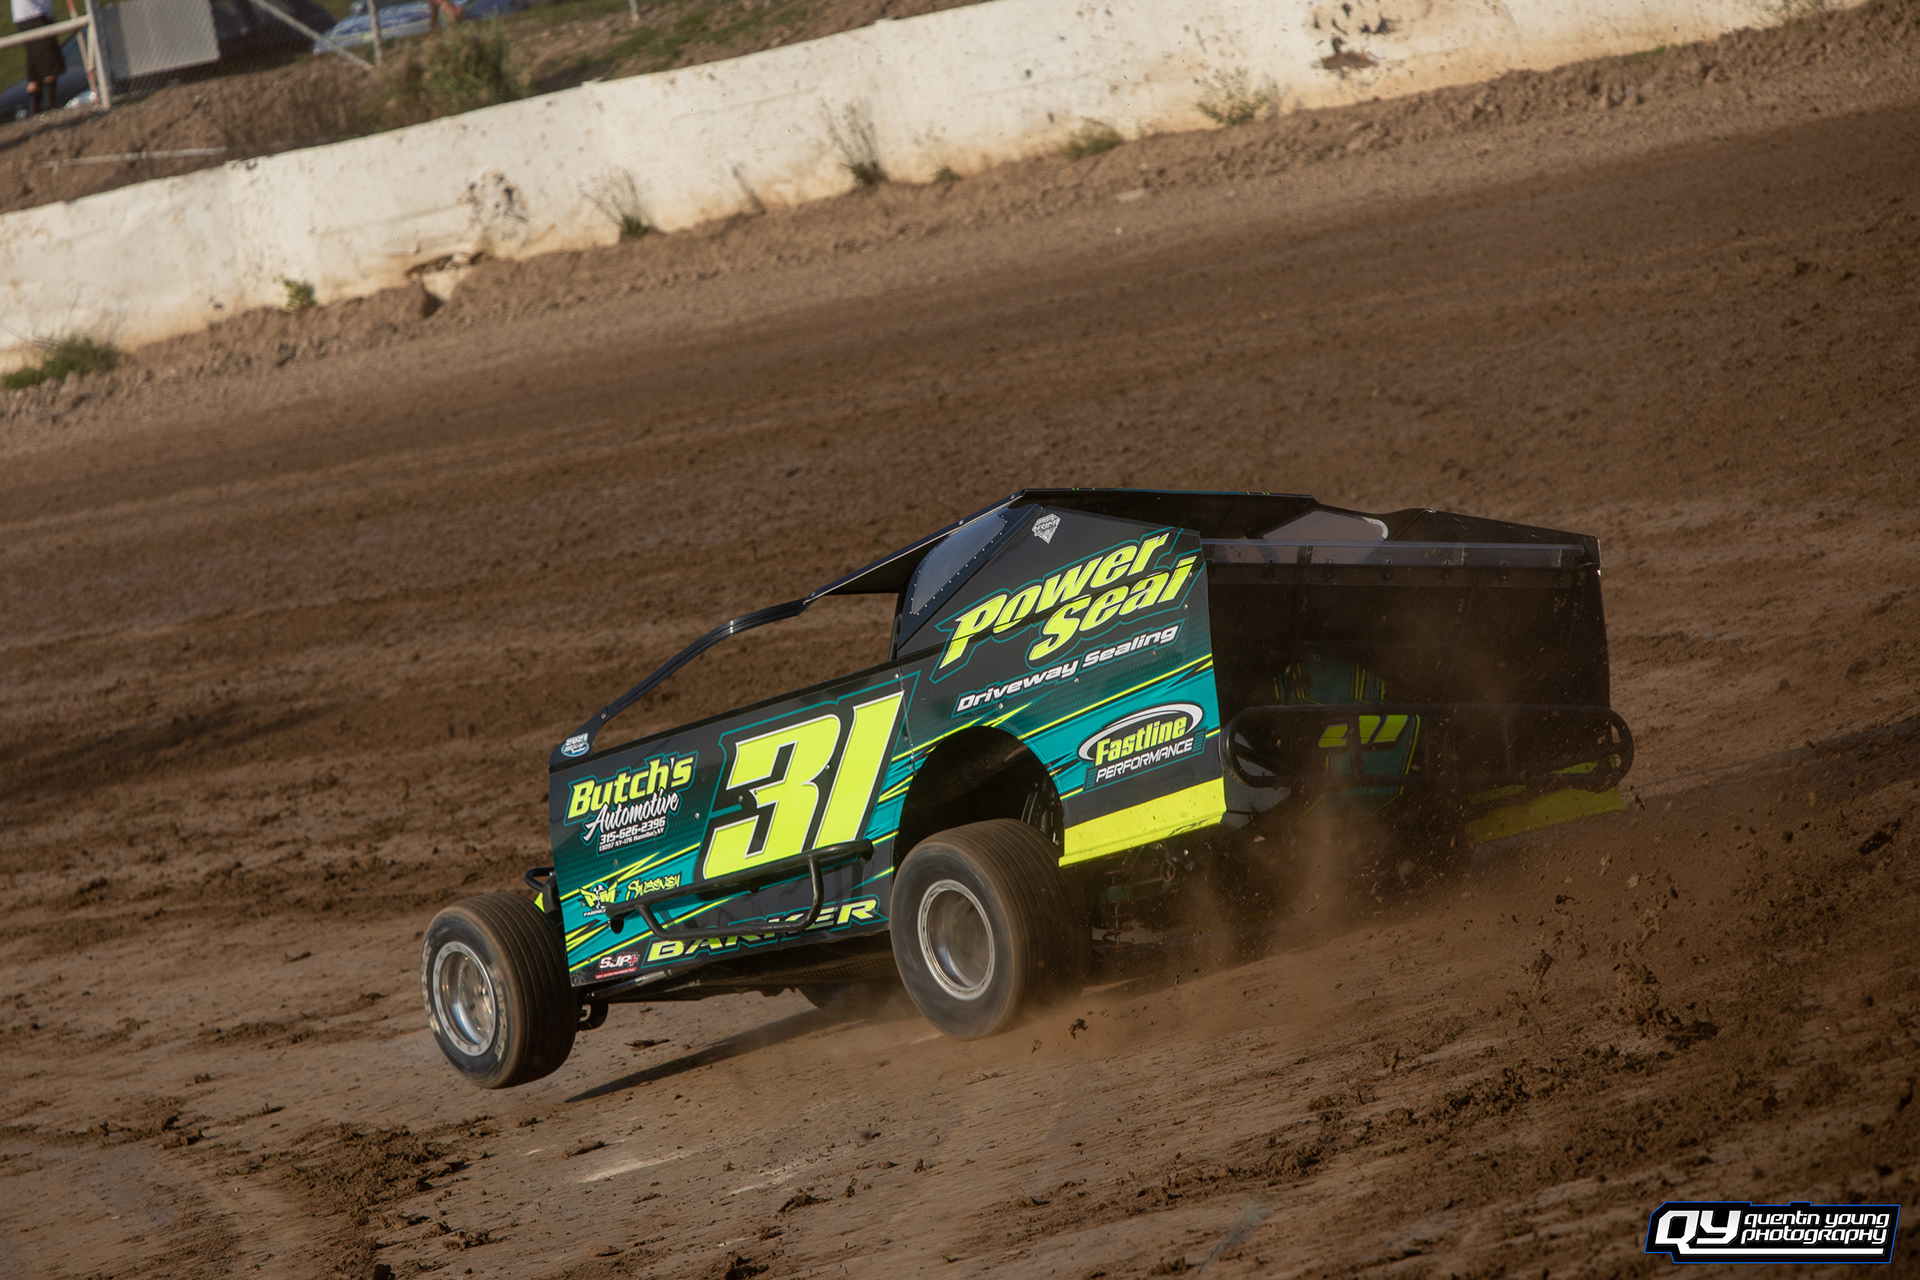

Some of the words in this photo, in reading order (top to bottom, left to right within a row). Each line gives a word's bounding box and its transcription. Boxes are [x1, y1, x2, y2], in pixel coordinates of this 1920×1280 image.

[939, 532, 1170, 669] Power
[1029, 555, 1197, 661] Seal
[957, 660, 1079, 712] Driveway
[1082, 625, 1179, 668] Sealing
[1095, 716, 1187, 766] Fastline
[1096, 738, 1194, 782] PERFORMANCE
[567, 757, 694, 819] Butch's
[583, 788, 679, 841] Automotive
[702, 690, 904, 880] 31
[600, 816, 666, 845] 315-626-2396
